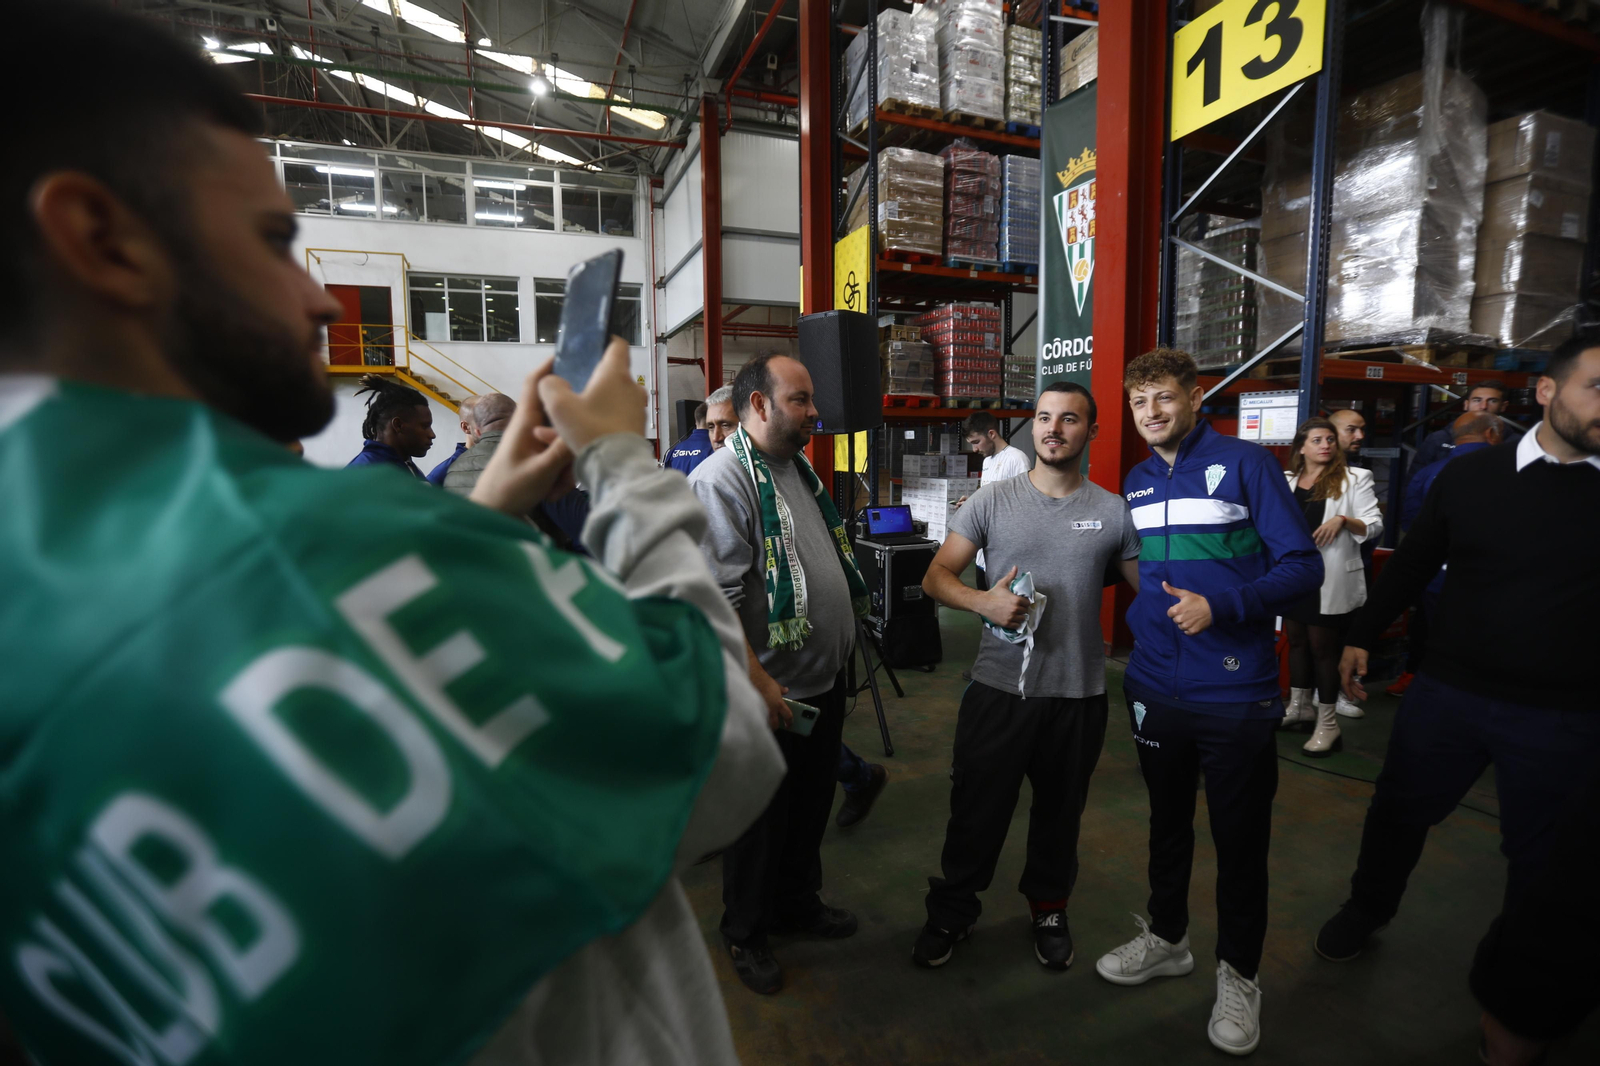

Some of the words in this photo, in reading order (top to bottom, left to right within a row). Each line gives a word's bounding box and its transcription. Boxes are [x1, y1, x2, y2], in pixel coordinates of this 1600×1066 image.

[1186, 0, 1304, 108] 13
[1041, 363, 1063, 376] CLUB
[1066, 362, 1077, 373] DE
[216, 551, 554, 863] DE
